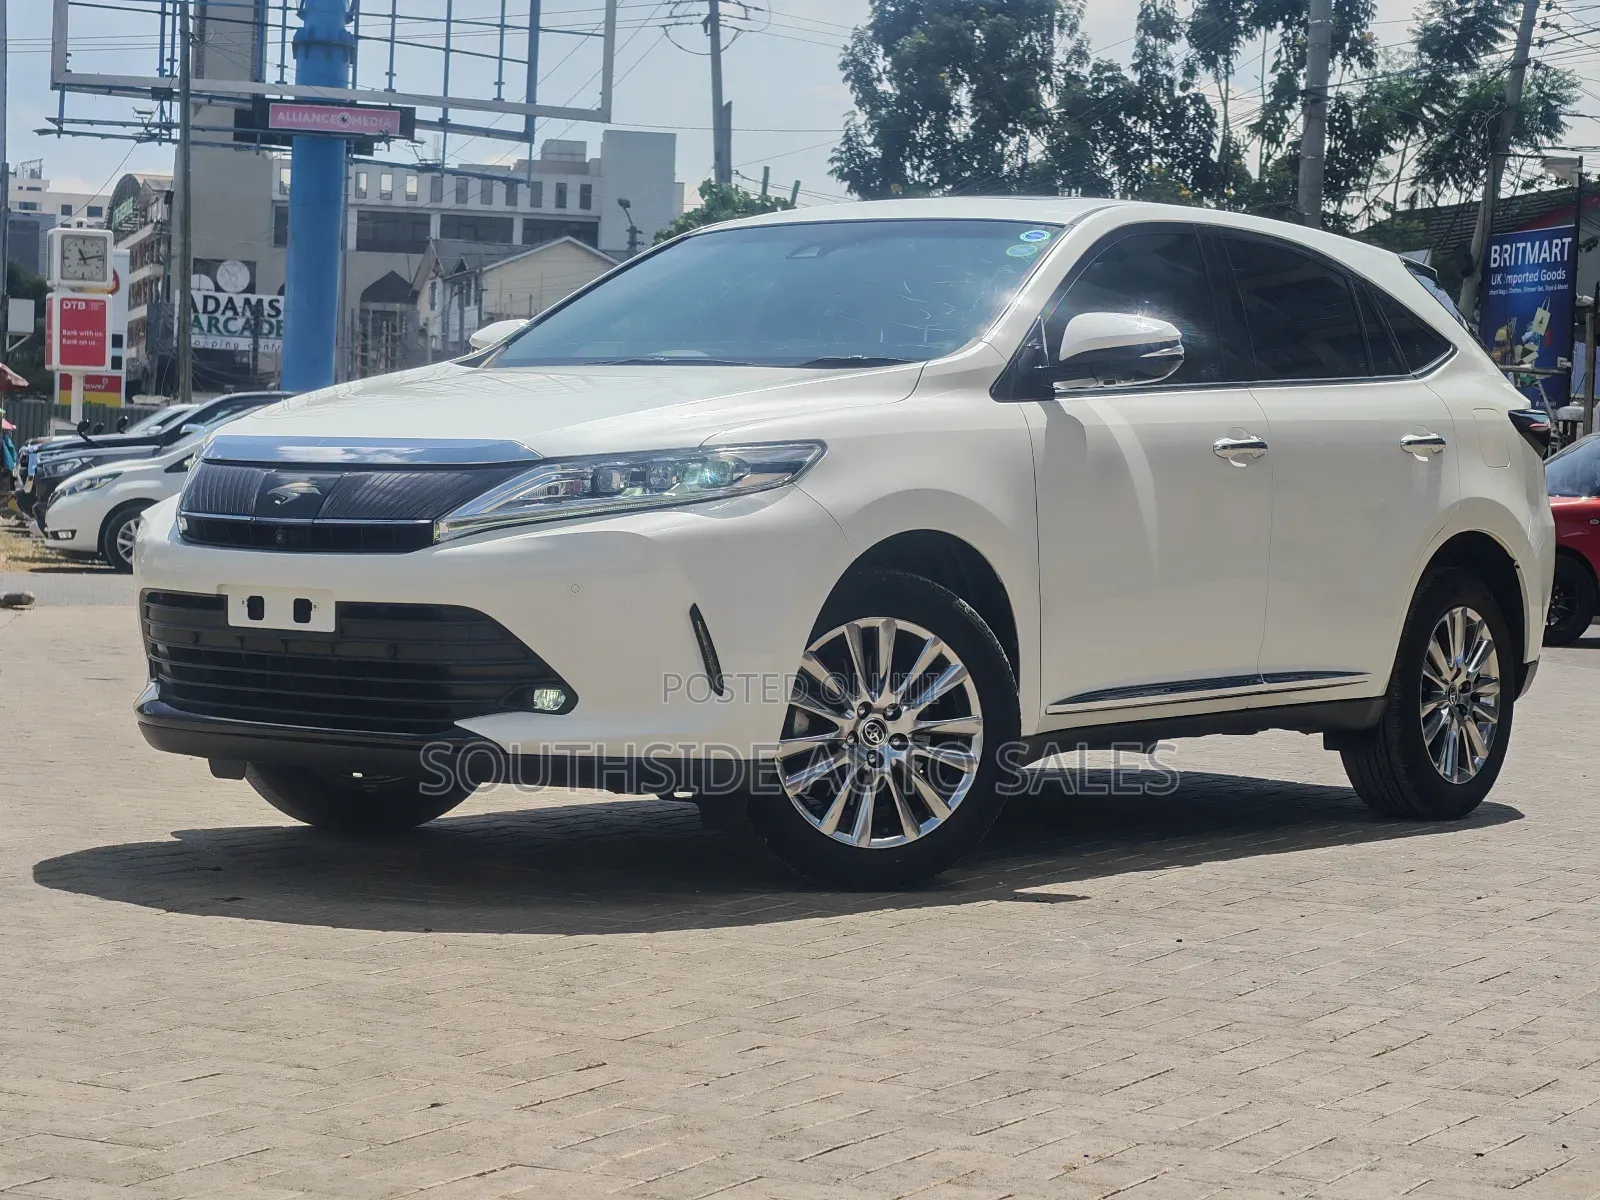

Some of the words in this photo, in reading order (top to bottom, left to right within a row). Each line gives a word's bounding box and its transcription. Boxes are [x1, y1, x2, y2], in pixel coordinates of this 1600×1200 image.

[277, 111, 337, 125] ALLIANCE
[351, 113, 392, 128] MEDIA
[1489, 237, 1573, 269] BRITMART
[1491, 273, 1503, 286] UK
[1540, 267, 1566, 282] Goods
[62, 301, 86, 310] DTB
[84, 382, 105, 390] ower
